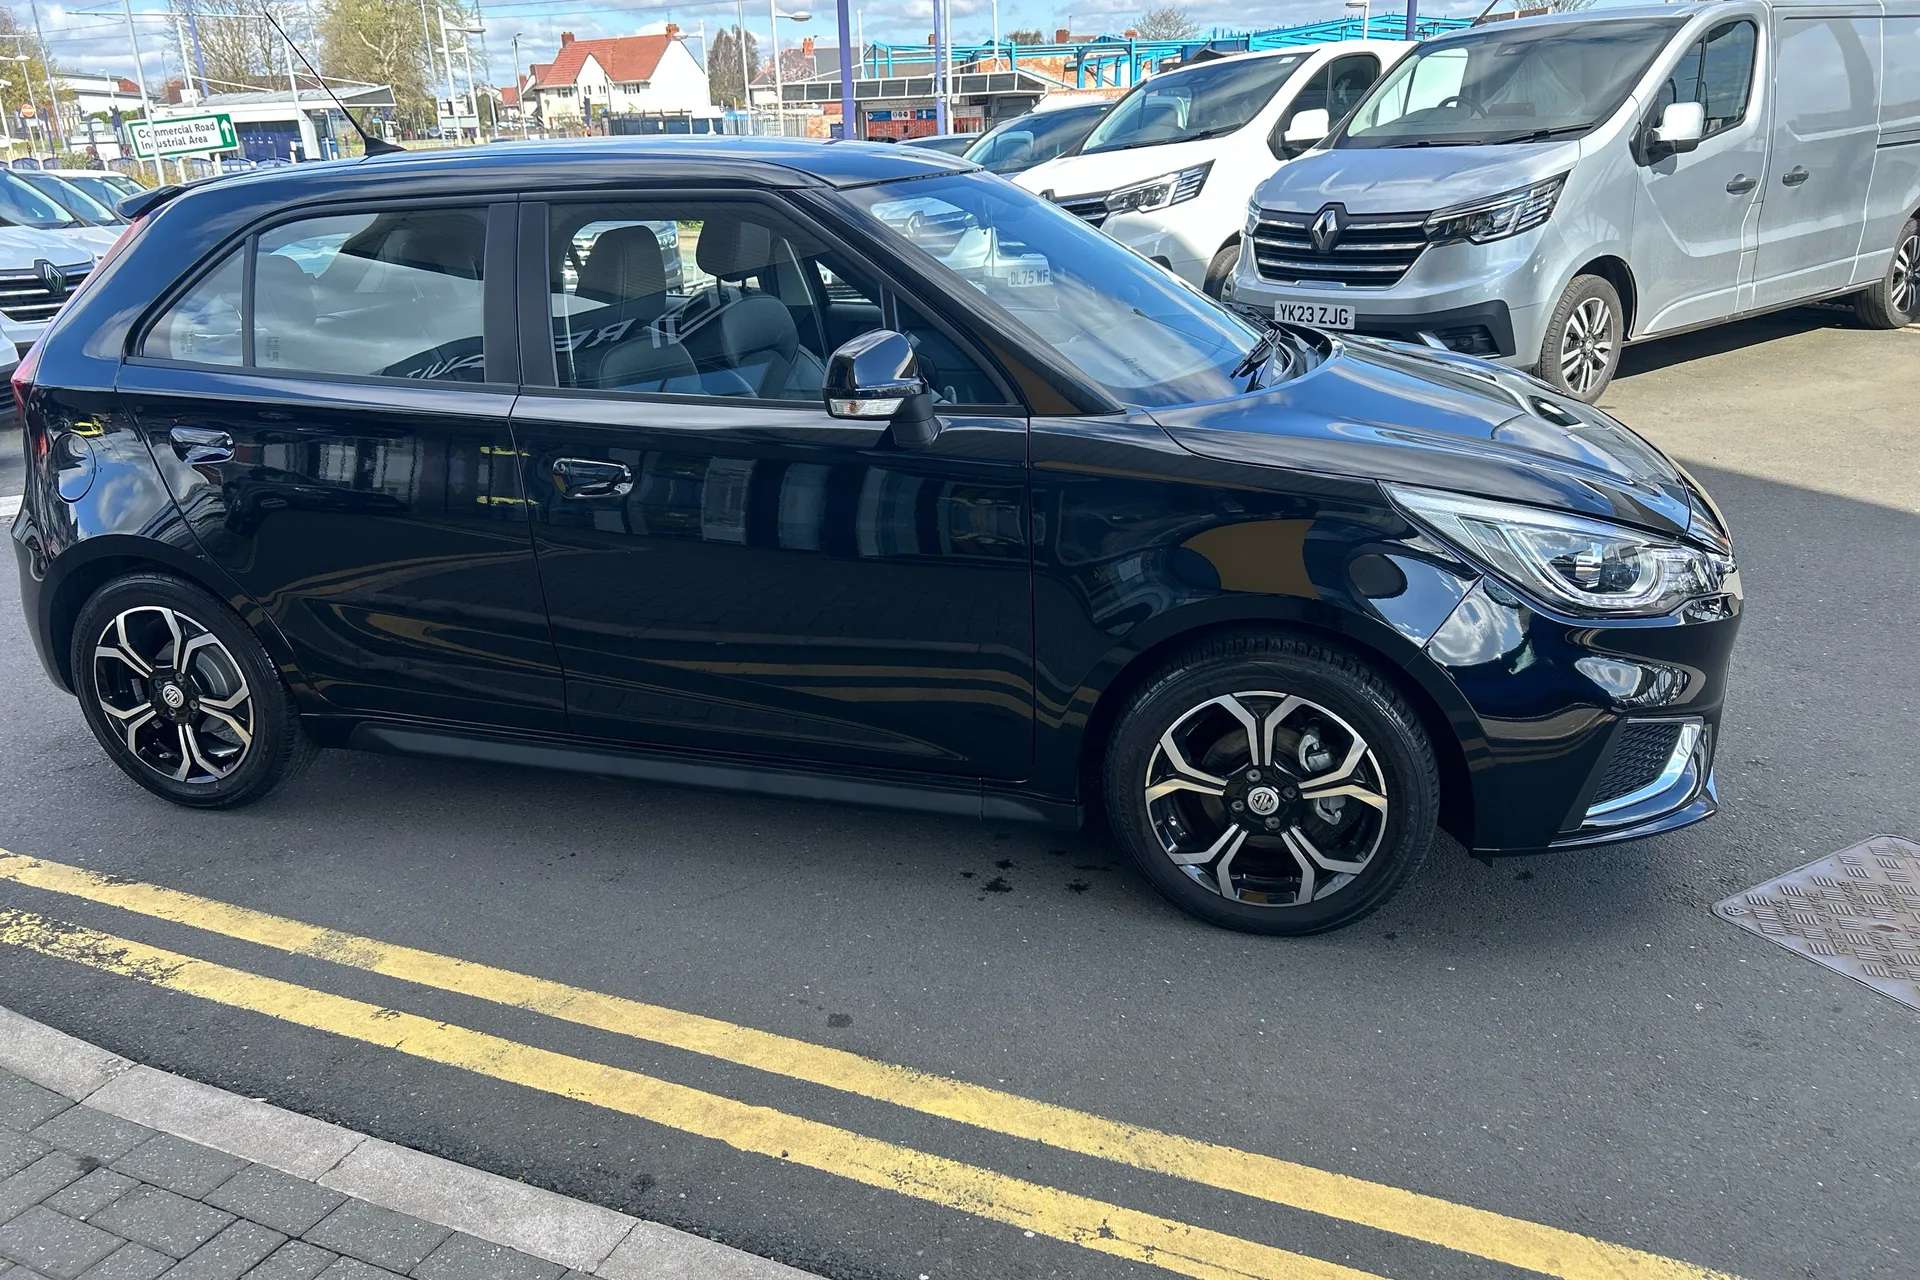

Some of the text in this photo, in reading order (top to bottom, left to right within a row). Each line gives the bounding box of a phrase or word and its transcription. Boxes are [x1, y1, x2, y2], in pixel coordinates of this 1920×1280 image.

[138, 122, 215, 139] Commercial Road
[189, 135, 208, 145] Area
[1280, 303, 1349, 326] YK23 ZJG
